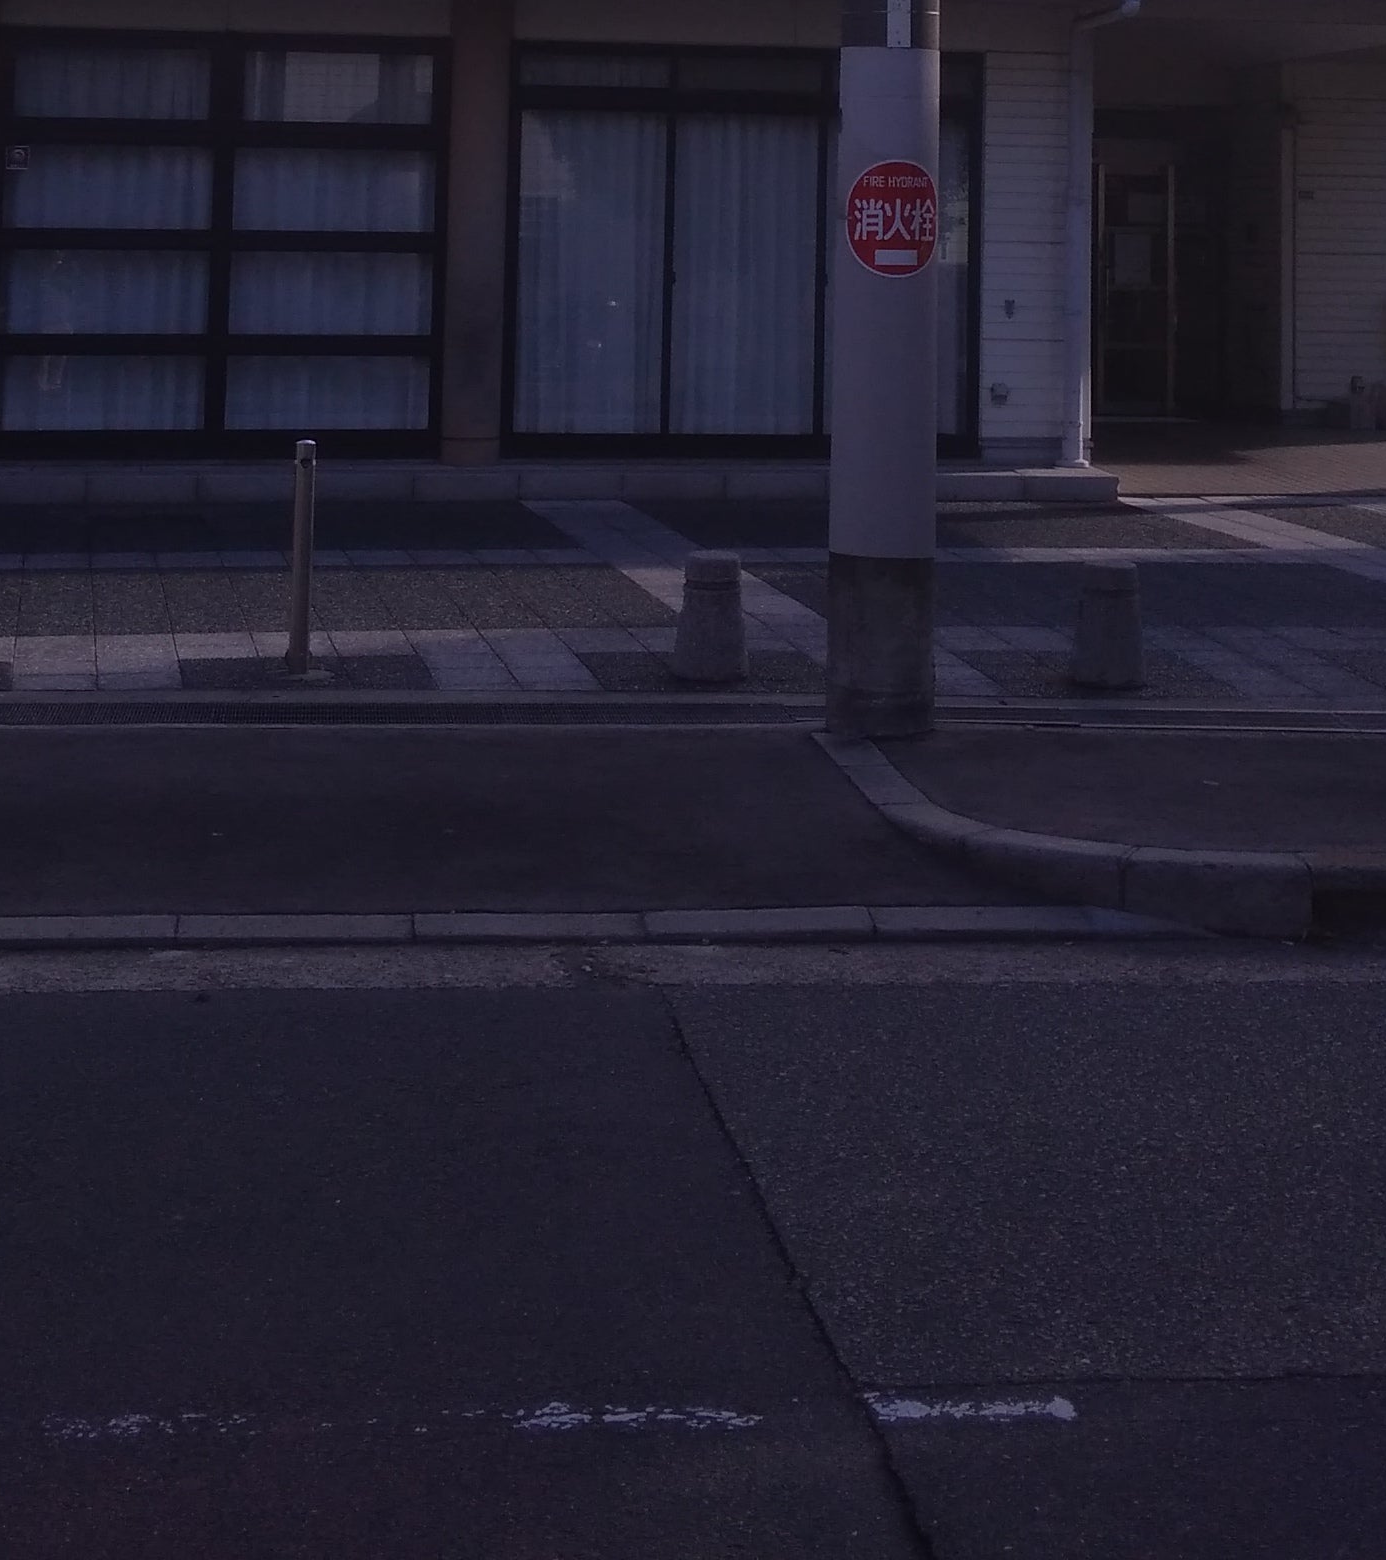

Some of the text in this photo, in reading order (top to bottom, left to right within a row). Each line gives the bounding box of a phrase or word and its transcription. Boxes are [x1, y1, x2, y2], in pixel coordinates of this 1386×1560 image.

[863, 176, 929, 188] FIRE HYDRANT
[854, 198, 935, 241] 消火栓
